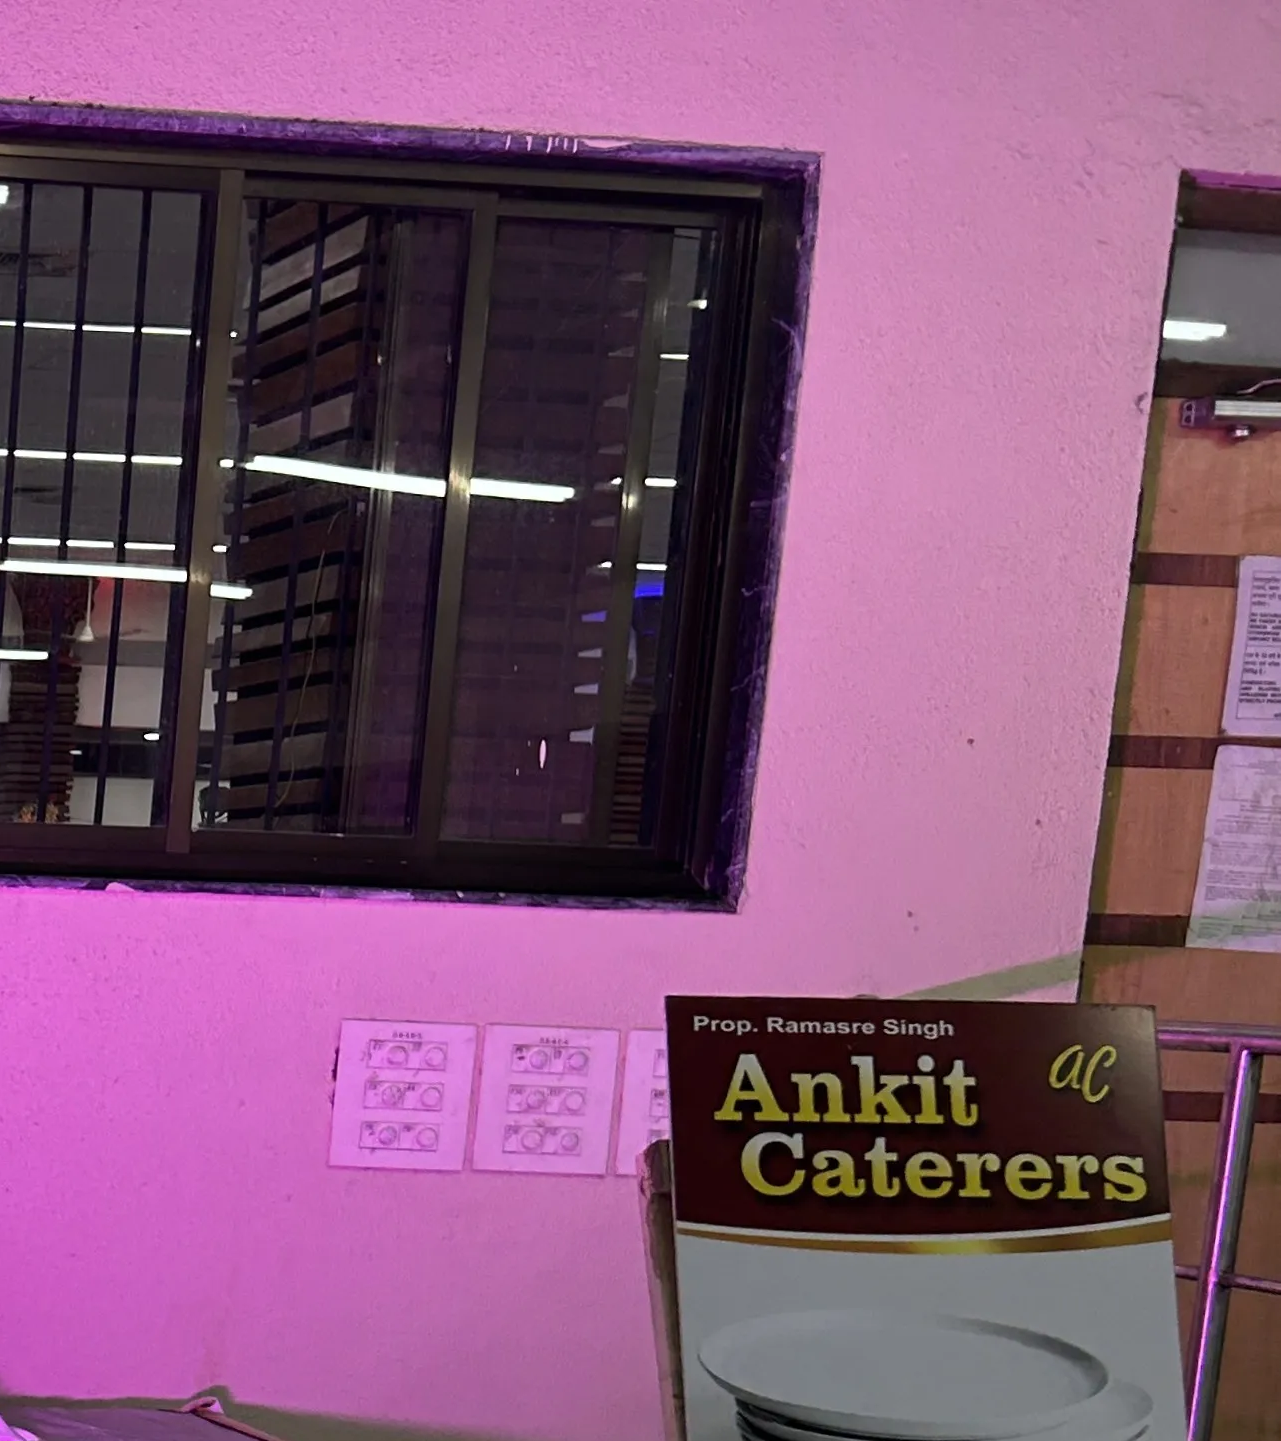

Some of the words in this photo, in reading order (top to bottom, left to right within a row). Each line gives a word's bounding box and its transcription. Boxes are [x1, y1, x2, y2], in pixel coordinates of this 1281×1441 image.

[693, 1015, 758, 1036] Prop.
[767, 1017, 875, 1036] Ramasre
[883, 1019, 954, 1039] Singh
[713, 1054, 979, 1126] Ankit
[740, 1132, 1148, 1202] Caterers
